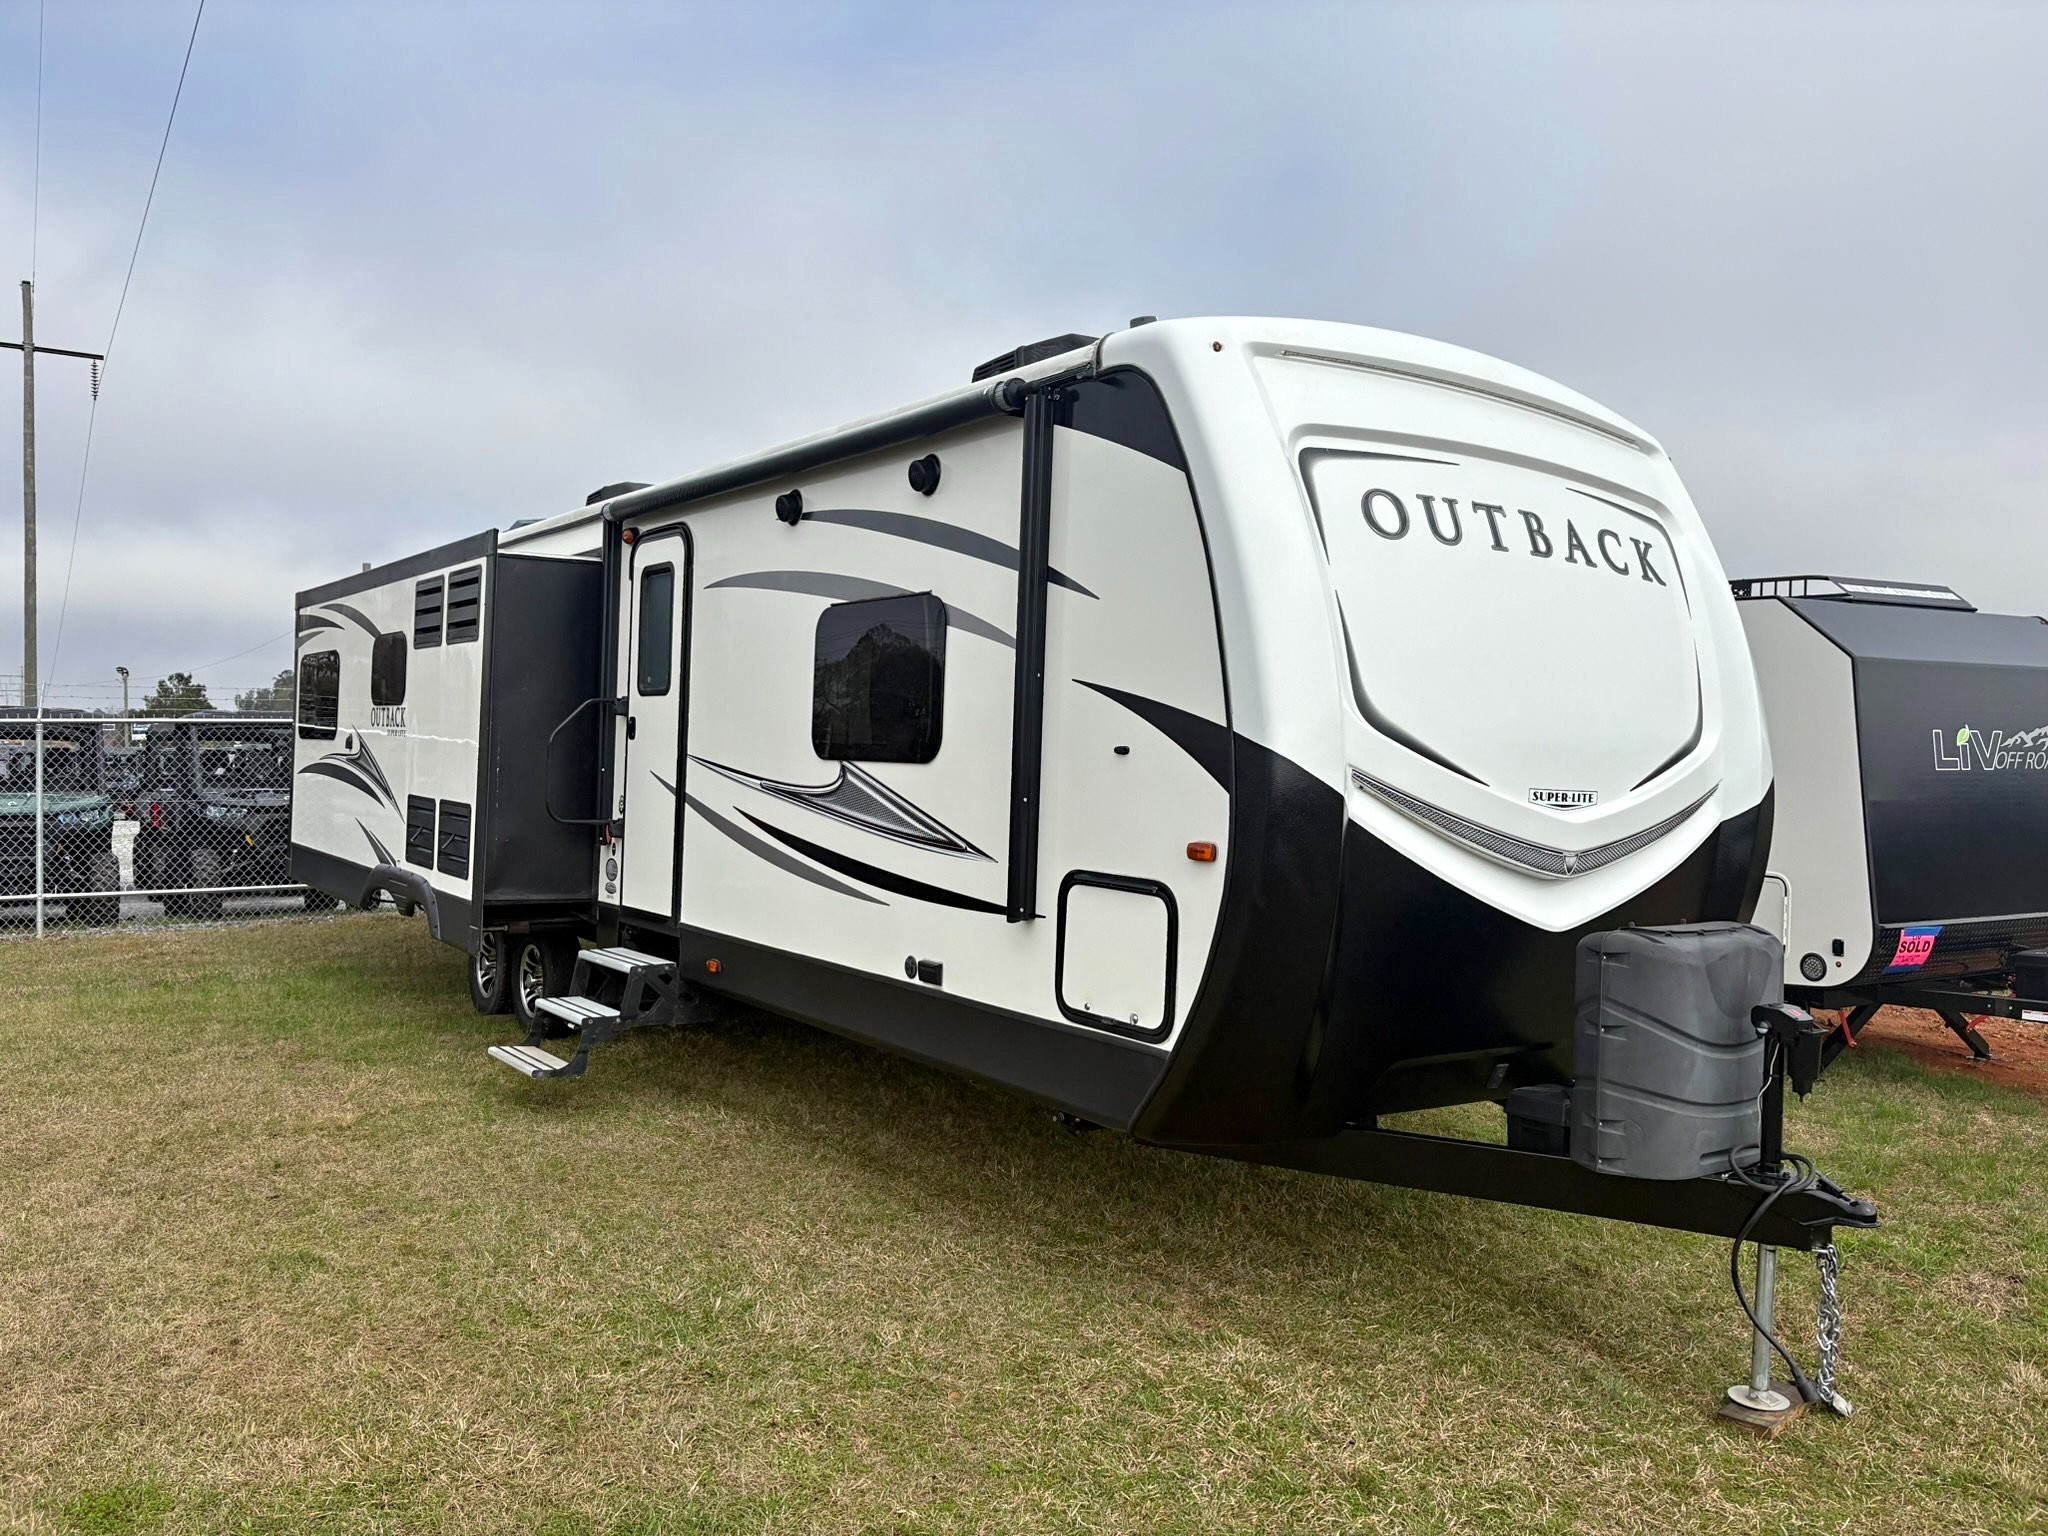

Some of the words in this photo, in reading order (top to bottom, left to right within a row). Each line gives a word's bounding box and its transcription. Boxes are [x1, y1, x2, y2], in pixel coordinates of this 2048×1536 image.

[1361, 488, 1667, 586] OUTBACK
[370, 707, 406, 727] OUTBACK
[1996, 751, 2024, 769] OFF
[1899, 940, 1931, 953] SOLD
